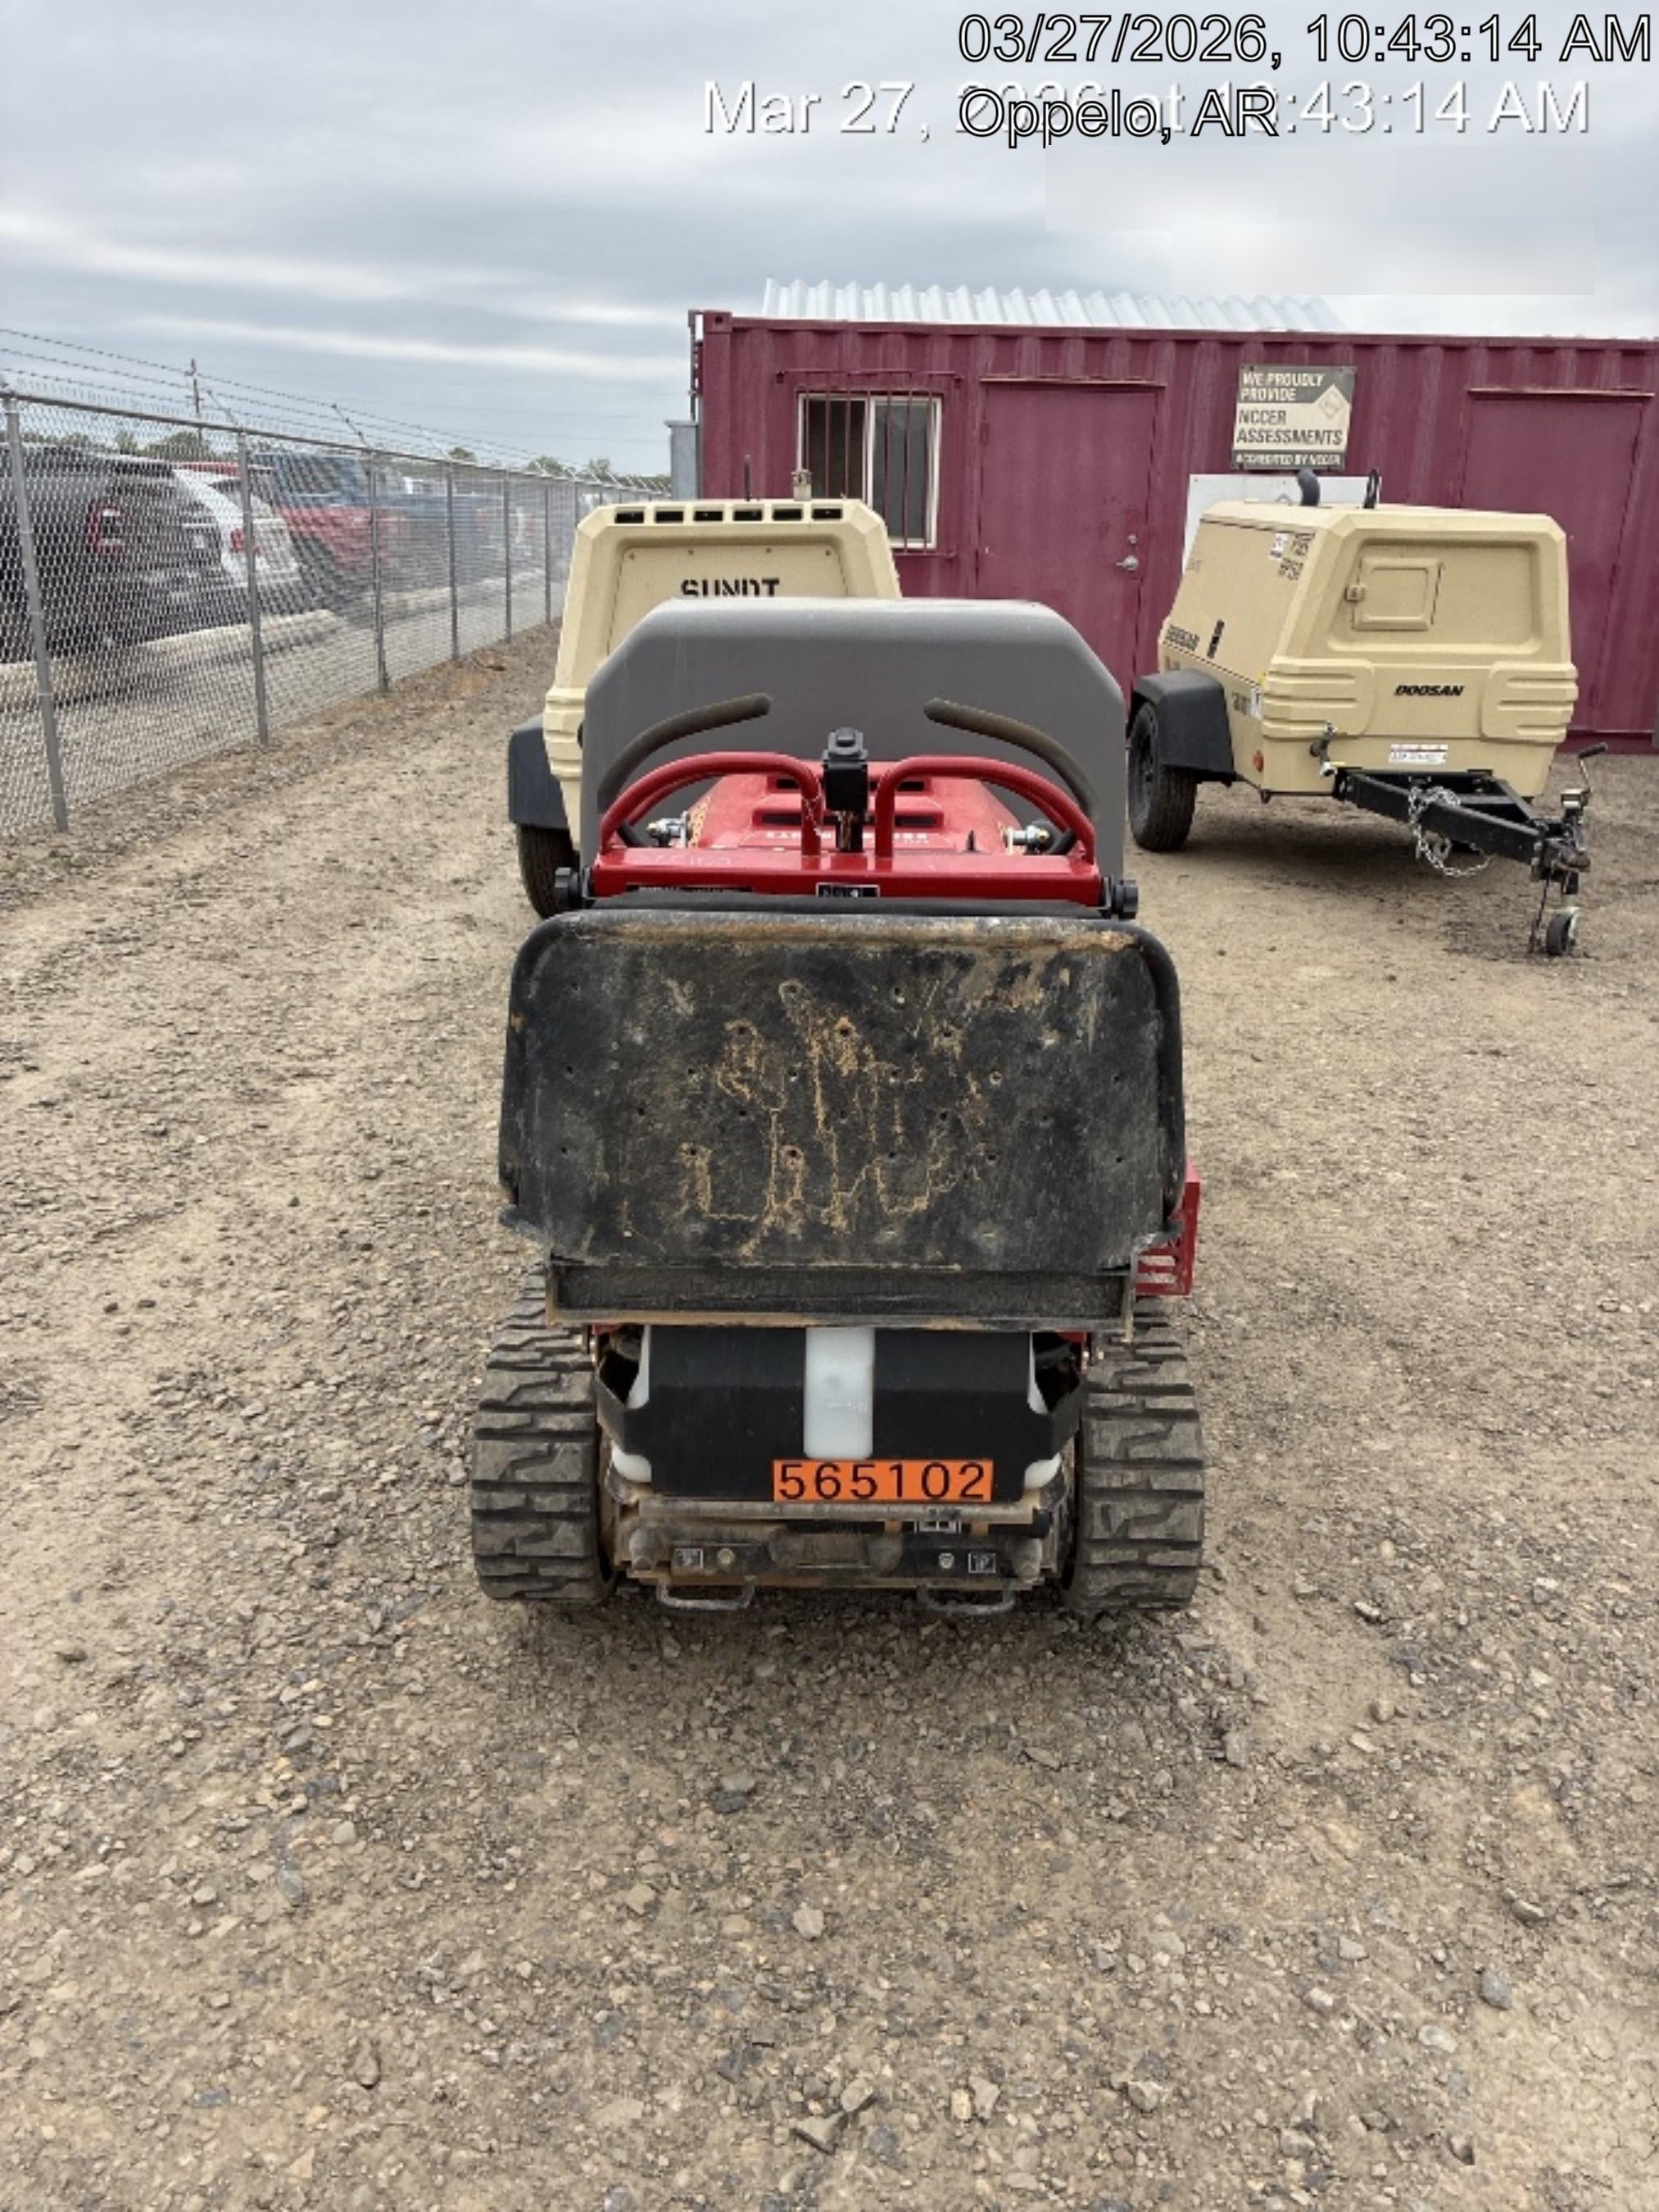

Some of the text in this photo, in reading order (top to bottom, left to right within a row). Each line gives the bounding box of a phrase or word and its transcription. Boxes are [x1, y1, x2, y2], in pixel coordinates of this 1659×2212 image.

[1243, 373, 1325, 387] WE PROUDLY
[1240, 388, 1297, 401] PROVIDE
[1239, 409, 1286, 424] NCCER
[1236, 428, 1343, 445] ASSESSMENTS
[1394, 685, 1464, 696] DOOSAN
[778, 1462, 984, 1499] 565102
